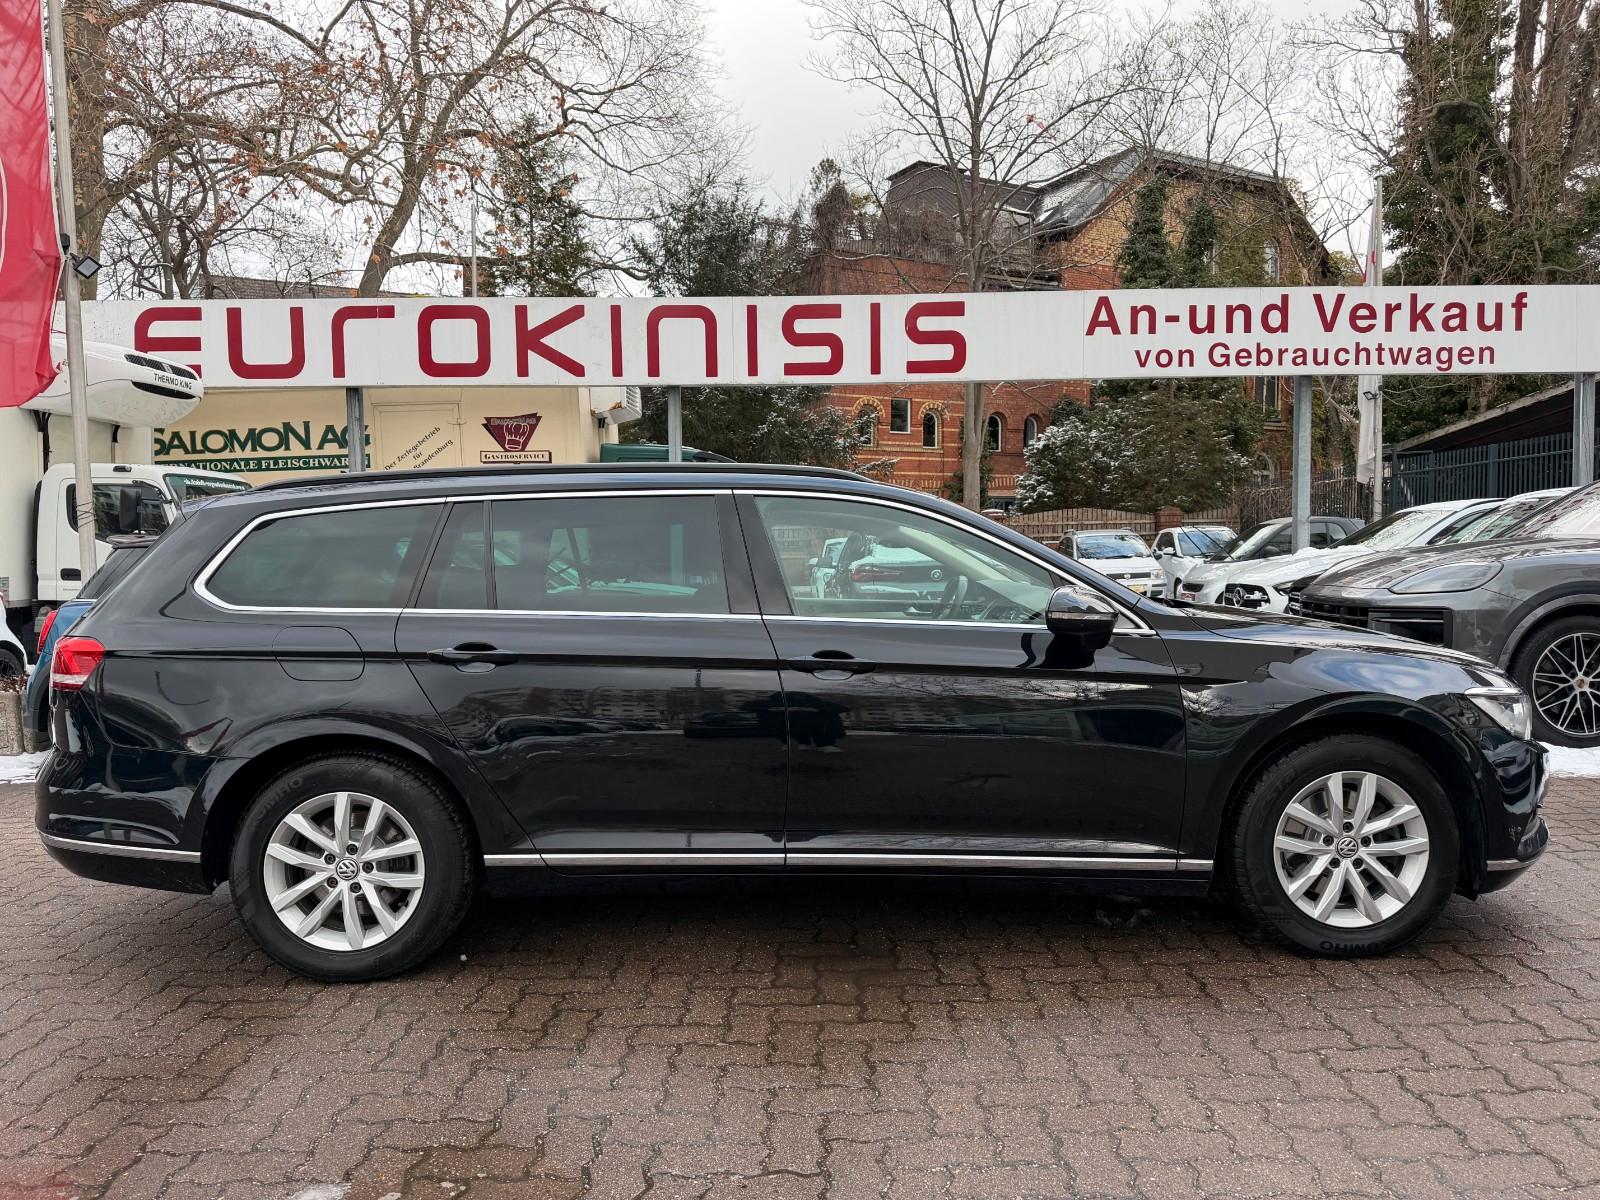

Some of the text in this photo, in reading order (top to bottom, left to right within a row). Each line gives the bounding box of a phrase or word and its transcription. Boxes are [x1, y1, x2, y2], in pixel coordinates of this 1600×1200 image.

[1312, 291, 1528, 334] Verkauf
[1135, 340, 1496, 371] von Gebrauchtwagen
[154, 373, 192, 390] THERMO KING
[261, 457, 368, 469] FLEISCHWAR
